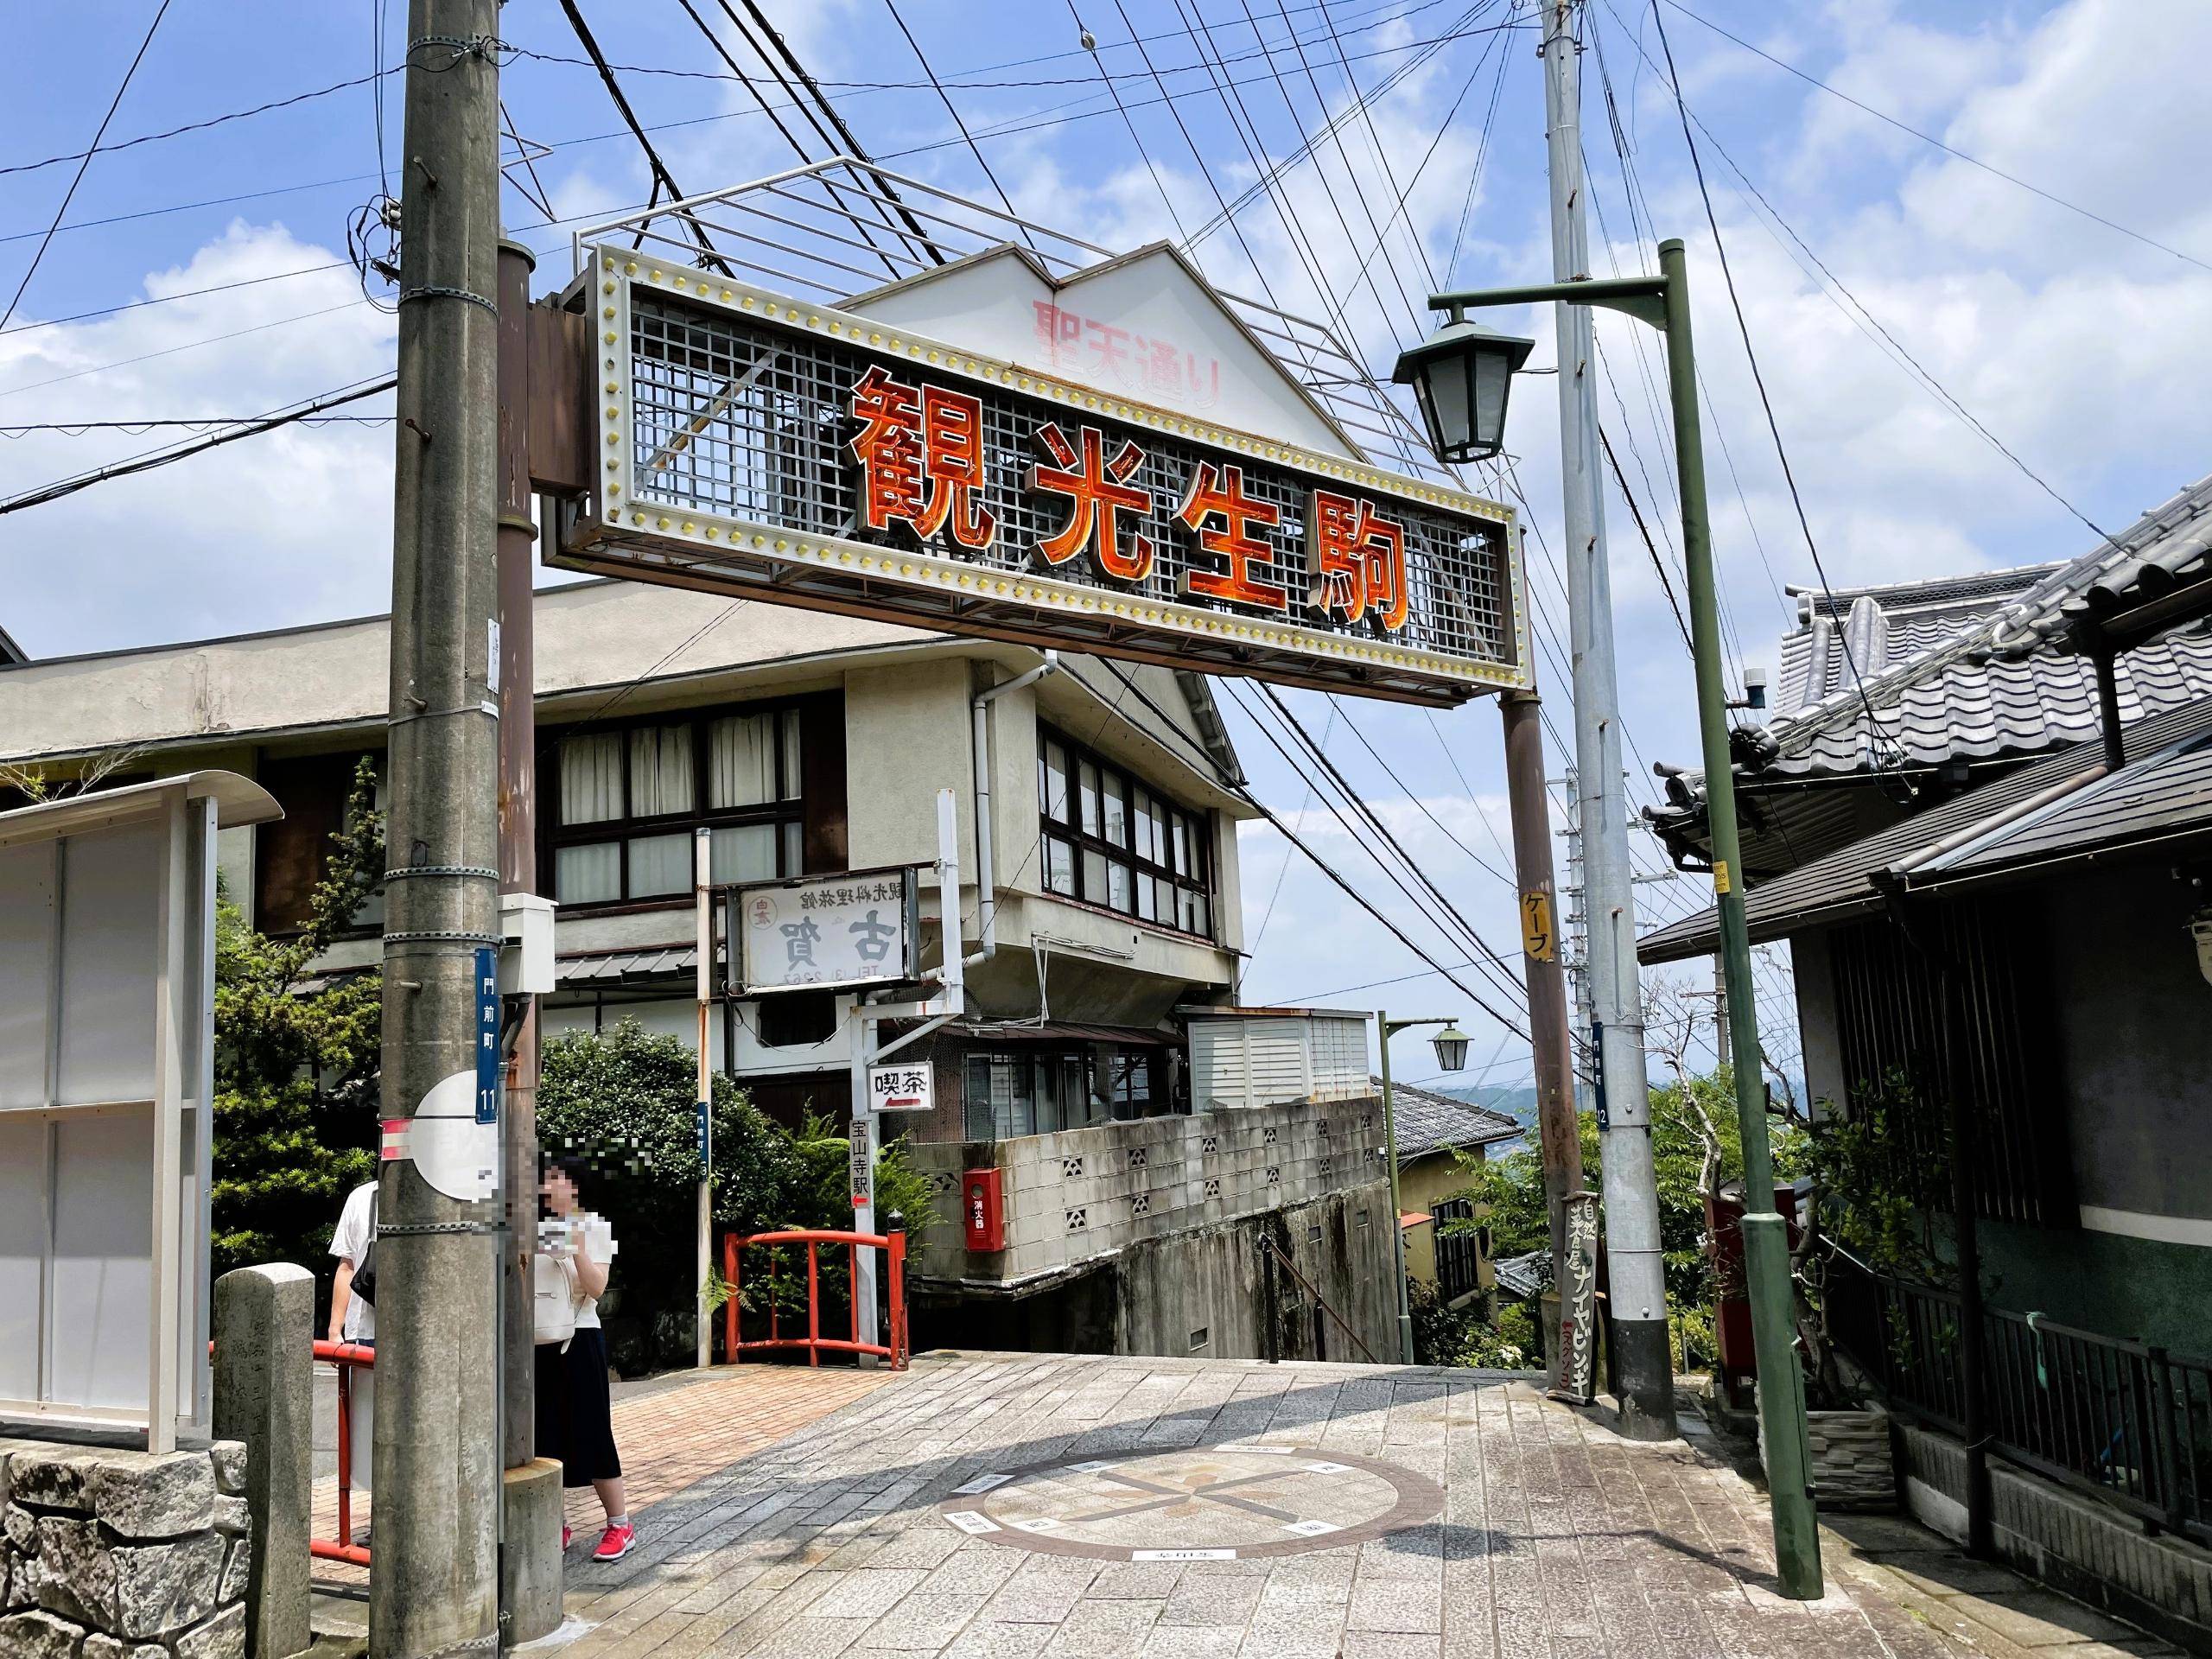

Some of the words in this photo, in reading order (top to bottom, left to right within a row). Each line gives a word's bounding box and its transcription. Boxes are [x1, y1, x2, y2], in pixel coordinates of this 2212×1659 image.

[1032, 299, 1221, 410] 聖天通り
[842, 365, 1410, 632] 観光生駒
[1526, 893, 1548, 953] ケーブ
[483, 977, 495, 1050] 門前町
[480, 1089, 496, 1110] 11
[874, 1071, 928, 1096] 喫茶
[1597, 1109, 1606, 1123] 12
[851, 1120, 868, 1195] 宝山寺駅
[973, 1200, 984, 1230] 消火器
[1565, 1205, 1584, 1272] 菜食屋
[1582, 1197, 1596, 1241] 自然
[1571, 1265, 1592, 1397] ナイヤビンギ
